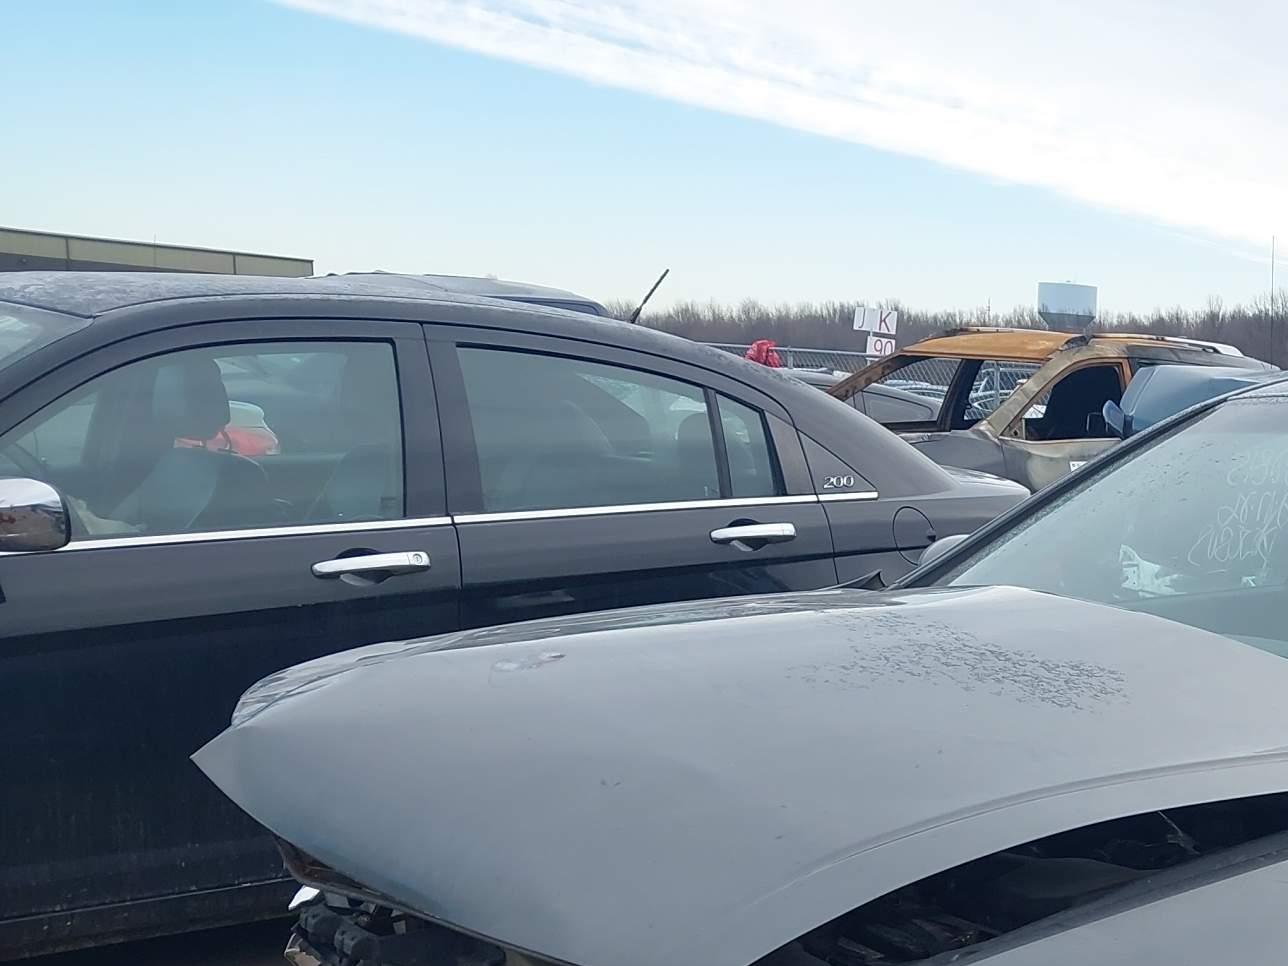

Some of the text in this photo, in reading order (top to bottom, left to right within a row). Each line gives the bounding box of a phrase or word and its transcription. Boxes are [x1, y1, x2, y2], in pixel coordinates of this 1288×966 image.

[857, 308, 892, 333] J K
[873, 338, 894, 356] 90
[823, 475, 855, 489] 200
